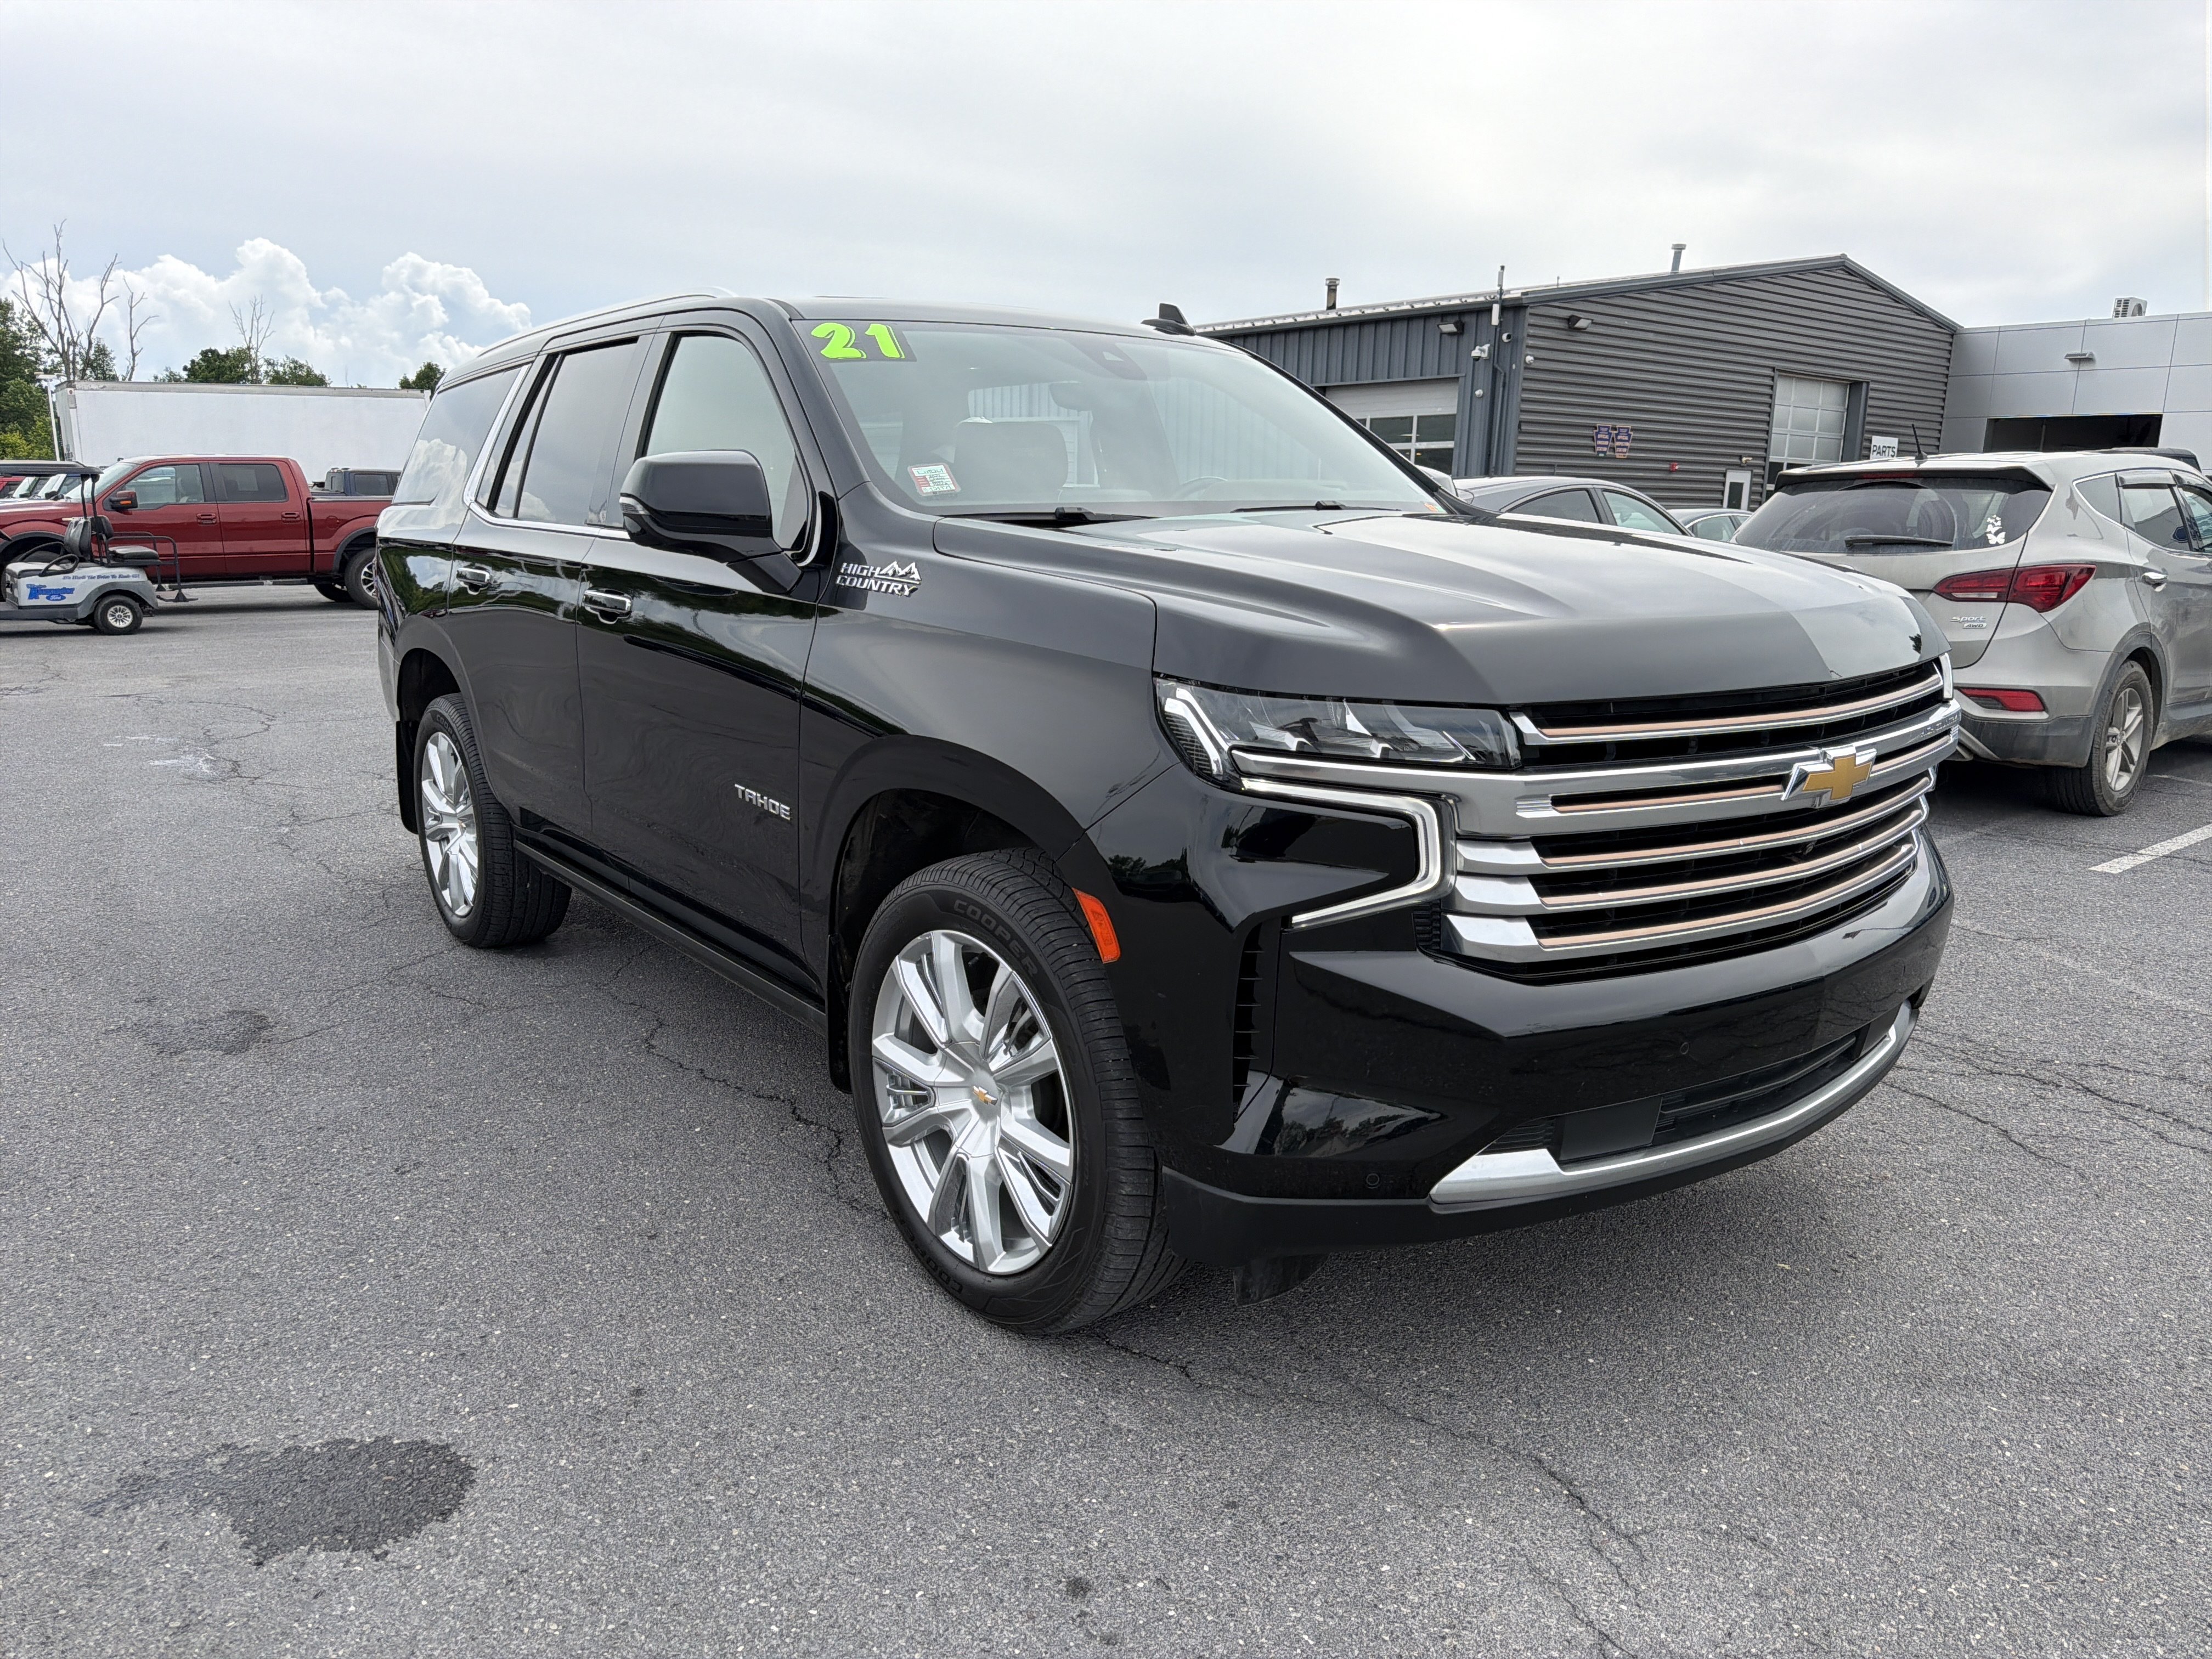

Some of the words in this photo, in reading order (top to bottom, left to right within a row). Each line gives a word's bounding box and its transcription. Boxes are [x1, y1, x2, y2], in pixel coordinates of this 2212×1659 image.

[811, 322, 905, 359] 21
[1872, 444, 1896, 458] PARTS
[840, 562, 881, 577] HIGH
[836, 575, 918, 596] COUNTRY
[734, 783, 791, 821] TAHOE
[953, 899, 1038, 976] COOPER
